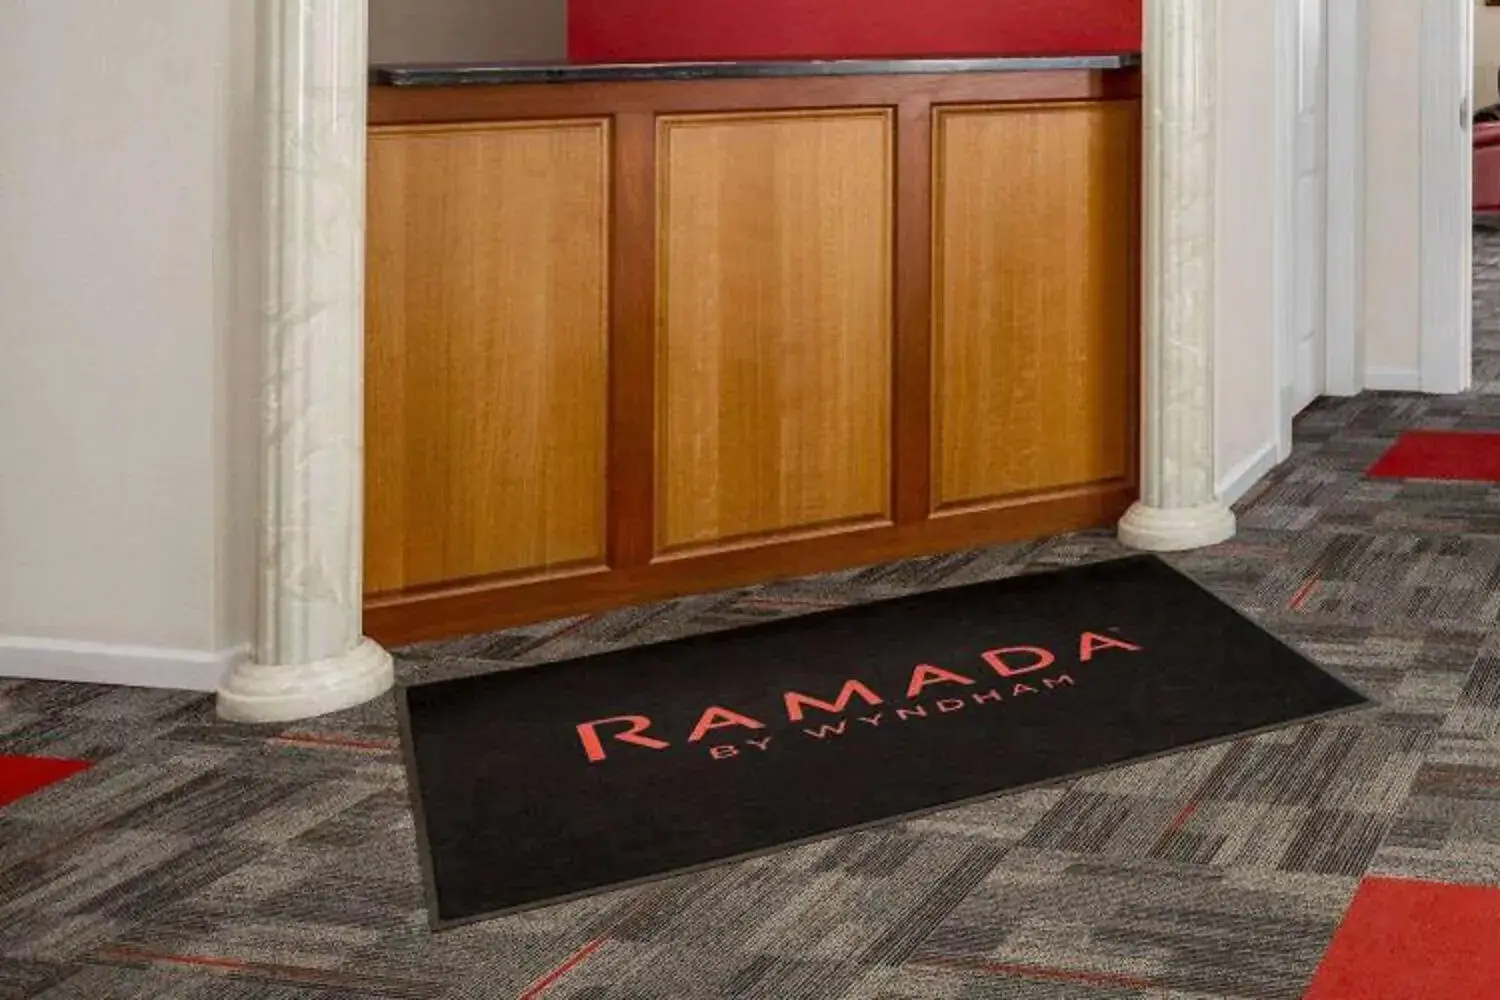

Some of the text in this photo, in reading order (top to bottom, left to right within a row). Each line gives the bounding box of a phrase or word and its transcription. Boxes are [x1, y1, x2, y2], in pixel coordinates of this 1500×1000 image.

[575, 631, 1142, 762] RAMADA
[709, 673, 1074, 760] BY WYNDHAM
